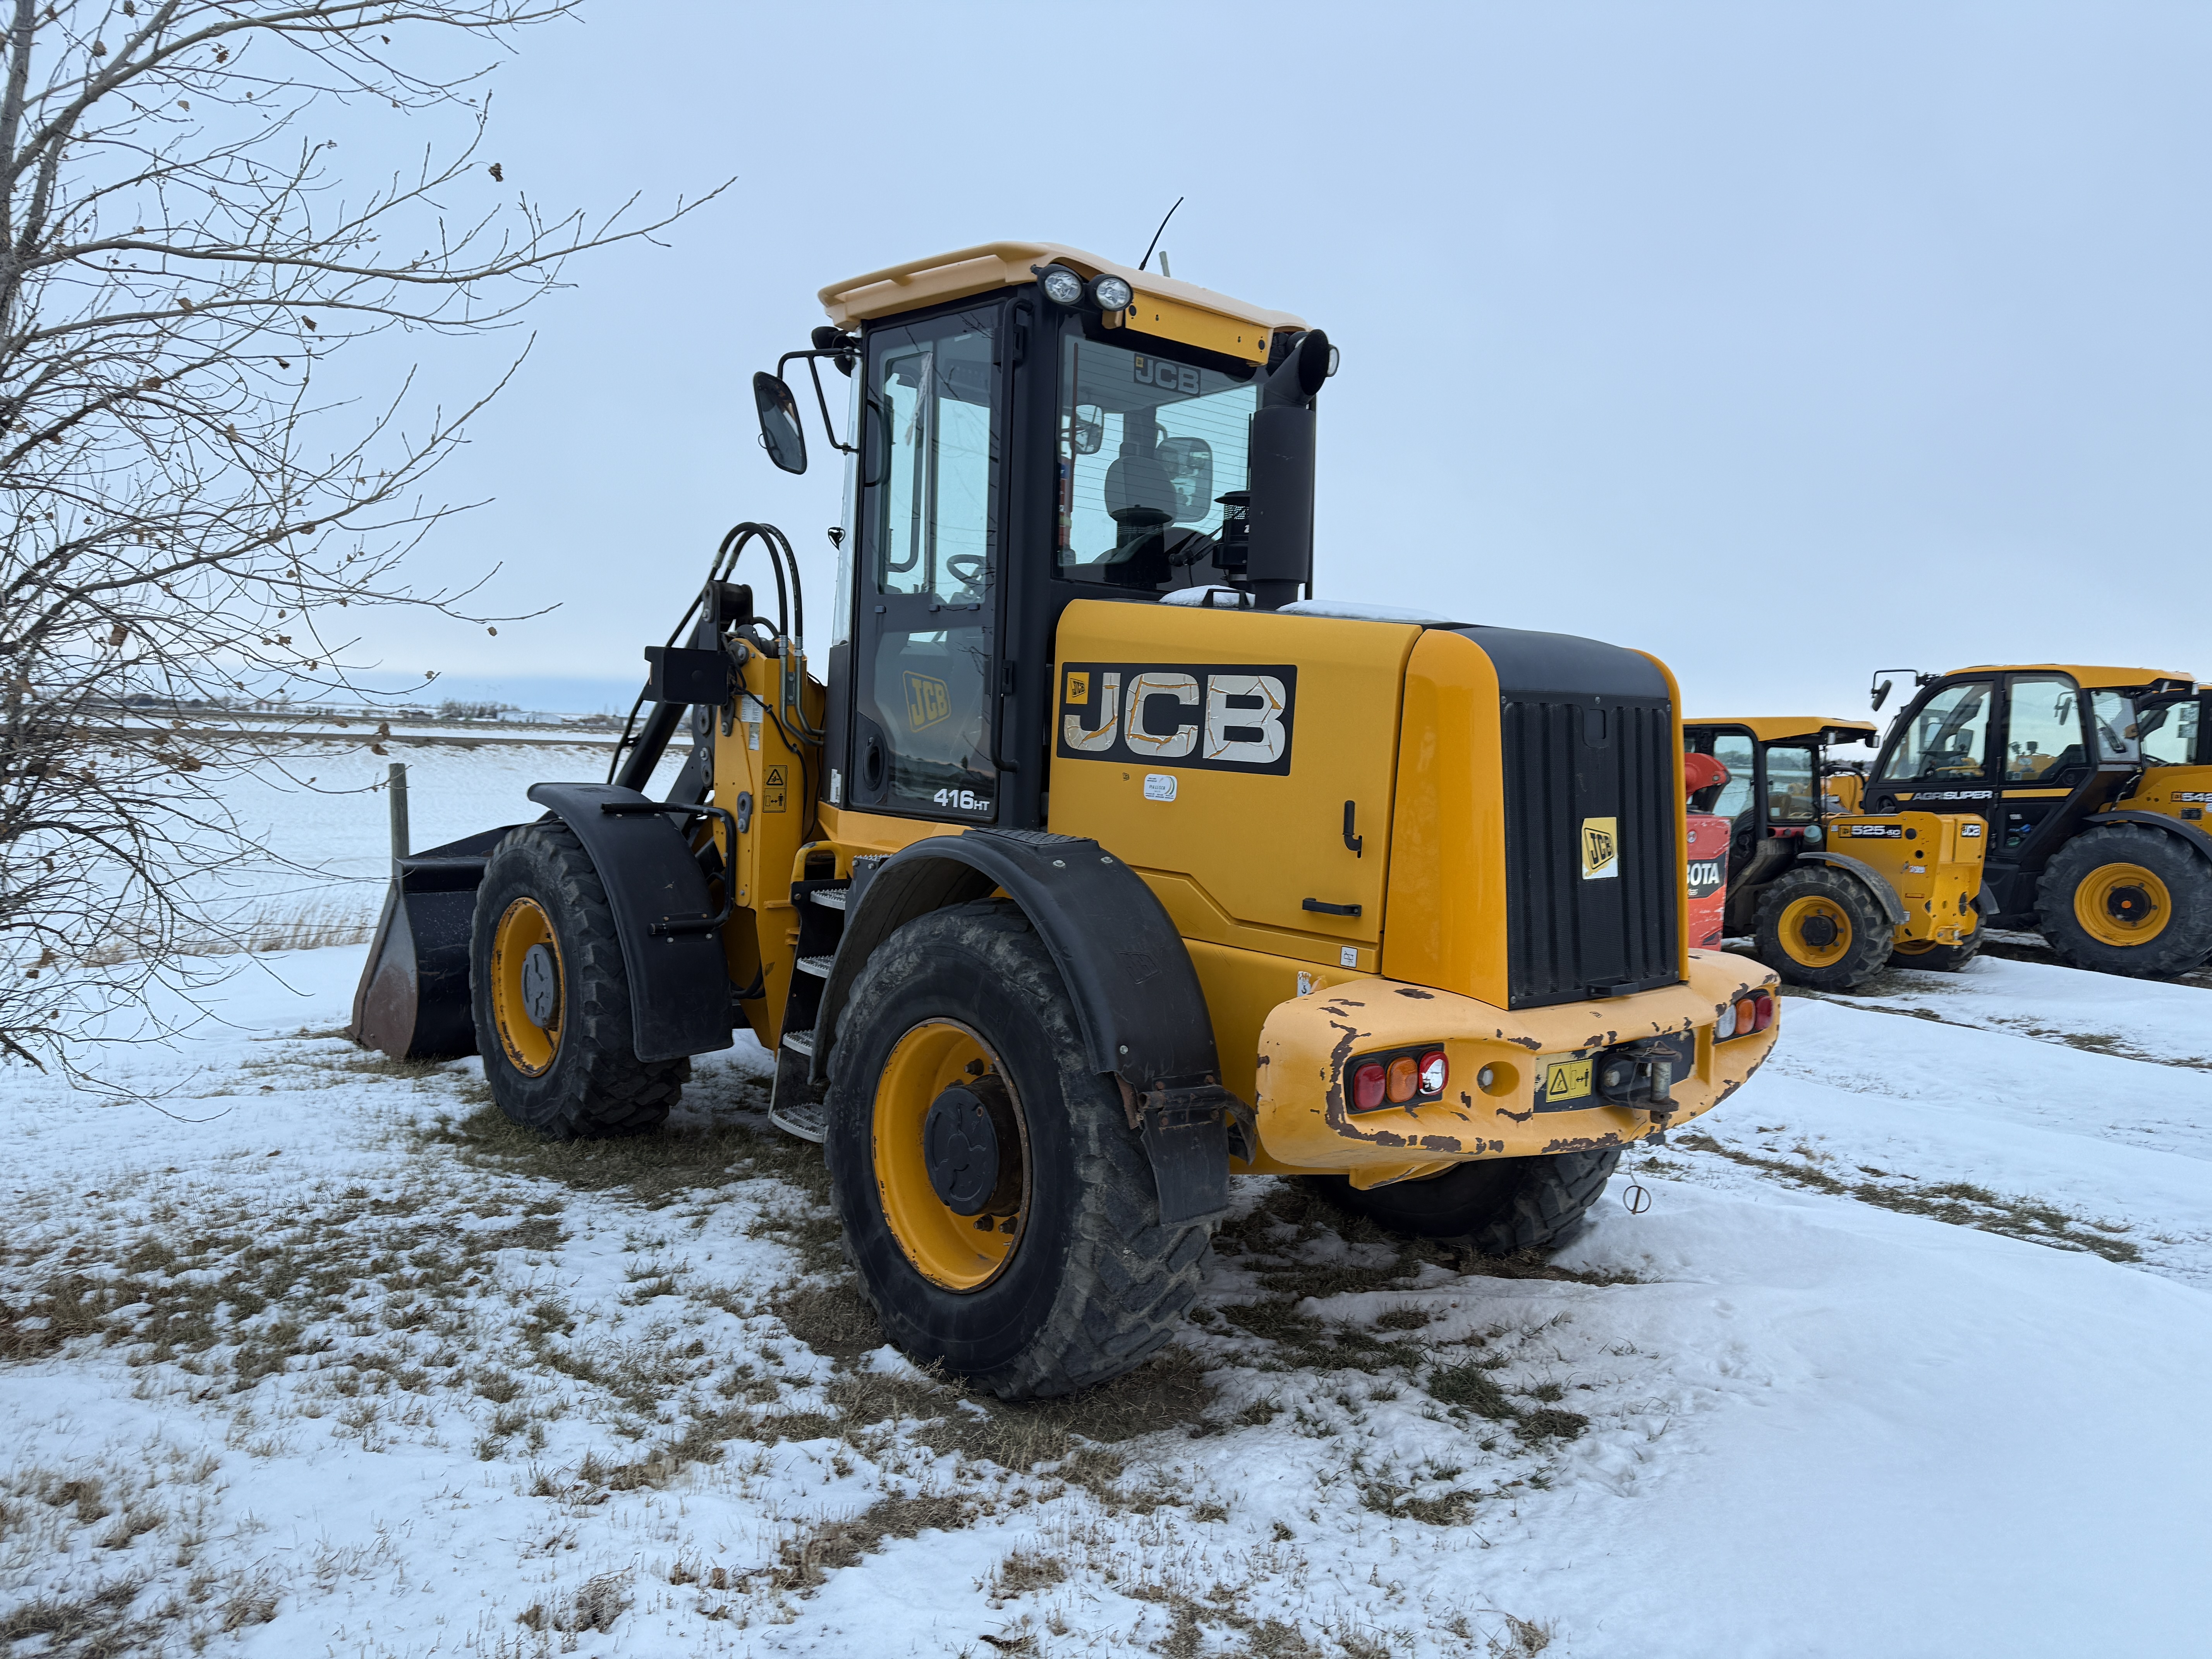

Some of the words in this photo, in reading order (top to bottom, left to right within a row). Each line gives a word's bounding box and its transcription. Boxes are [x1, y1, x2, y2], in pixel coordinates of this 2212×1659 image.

[1136, 359, 1199, 394] JCB
[912, 678, 948, 725] JCB
[1064, 672, 1286, 763] JCB
[1590, 833, 1612, 864] JCB
